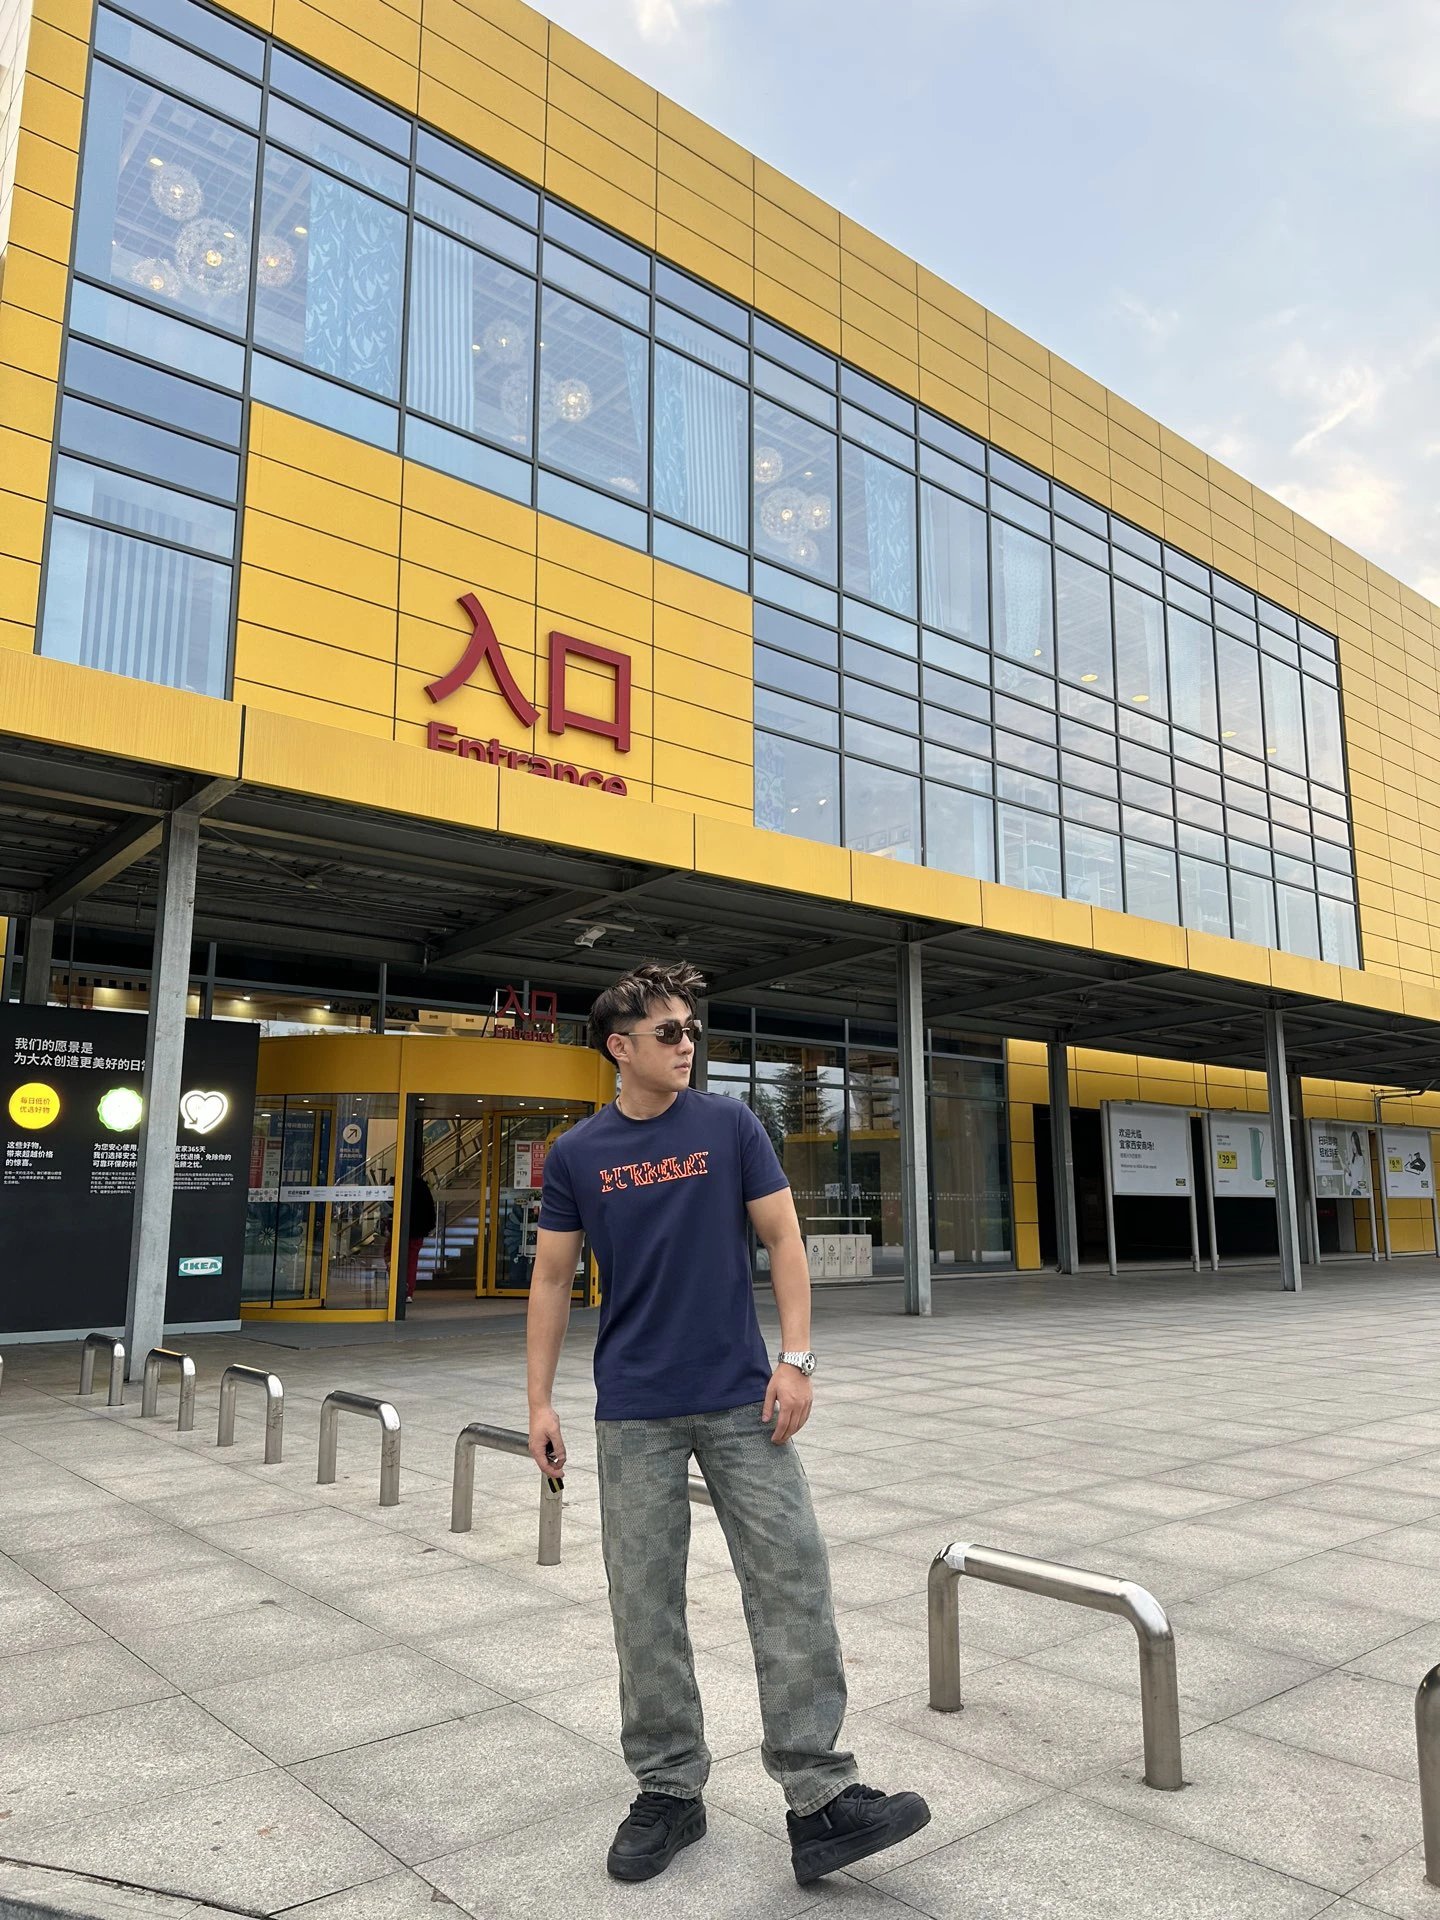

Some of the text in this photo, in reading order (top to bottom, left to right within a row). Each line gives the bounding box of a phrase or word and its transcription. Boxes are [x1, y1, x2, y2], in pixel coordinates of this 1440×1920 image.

[424, 592, 631, 753] 入口
[427, 721, 628, 797] Entrance
[497, 985, 557, 1024] 入口
[496, 1025, 554, 1043] Entrance
[14, 1037, 94, 1054] 我们的愿景是
[92, 1159, 138, 1168] 可靠环保的材
[183, 1262, 219, 1270] IKEA
